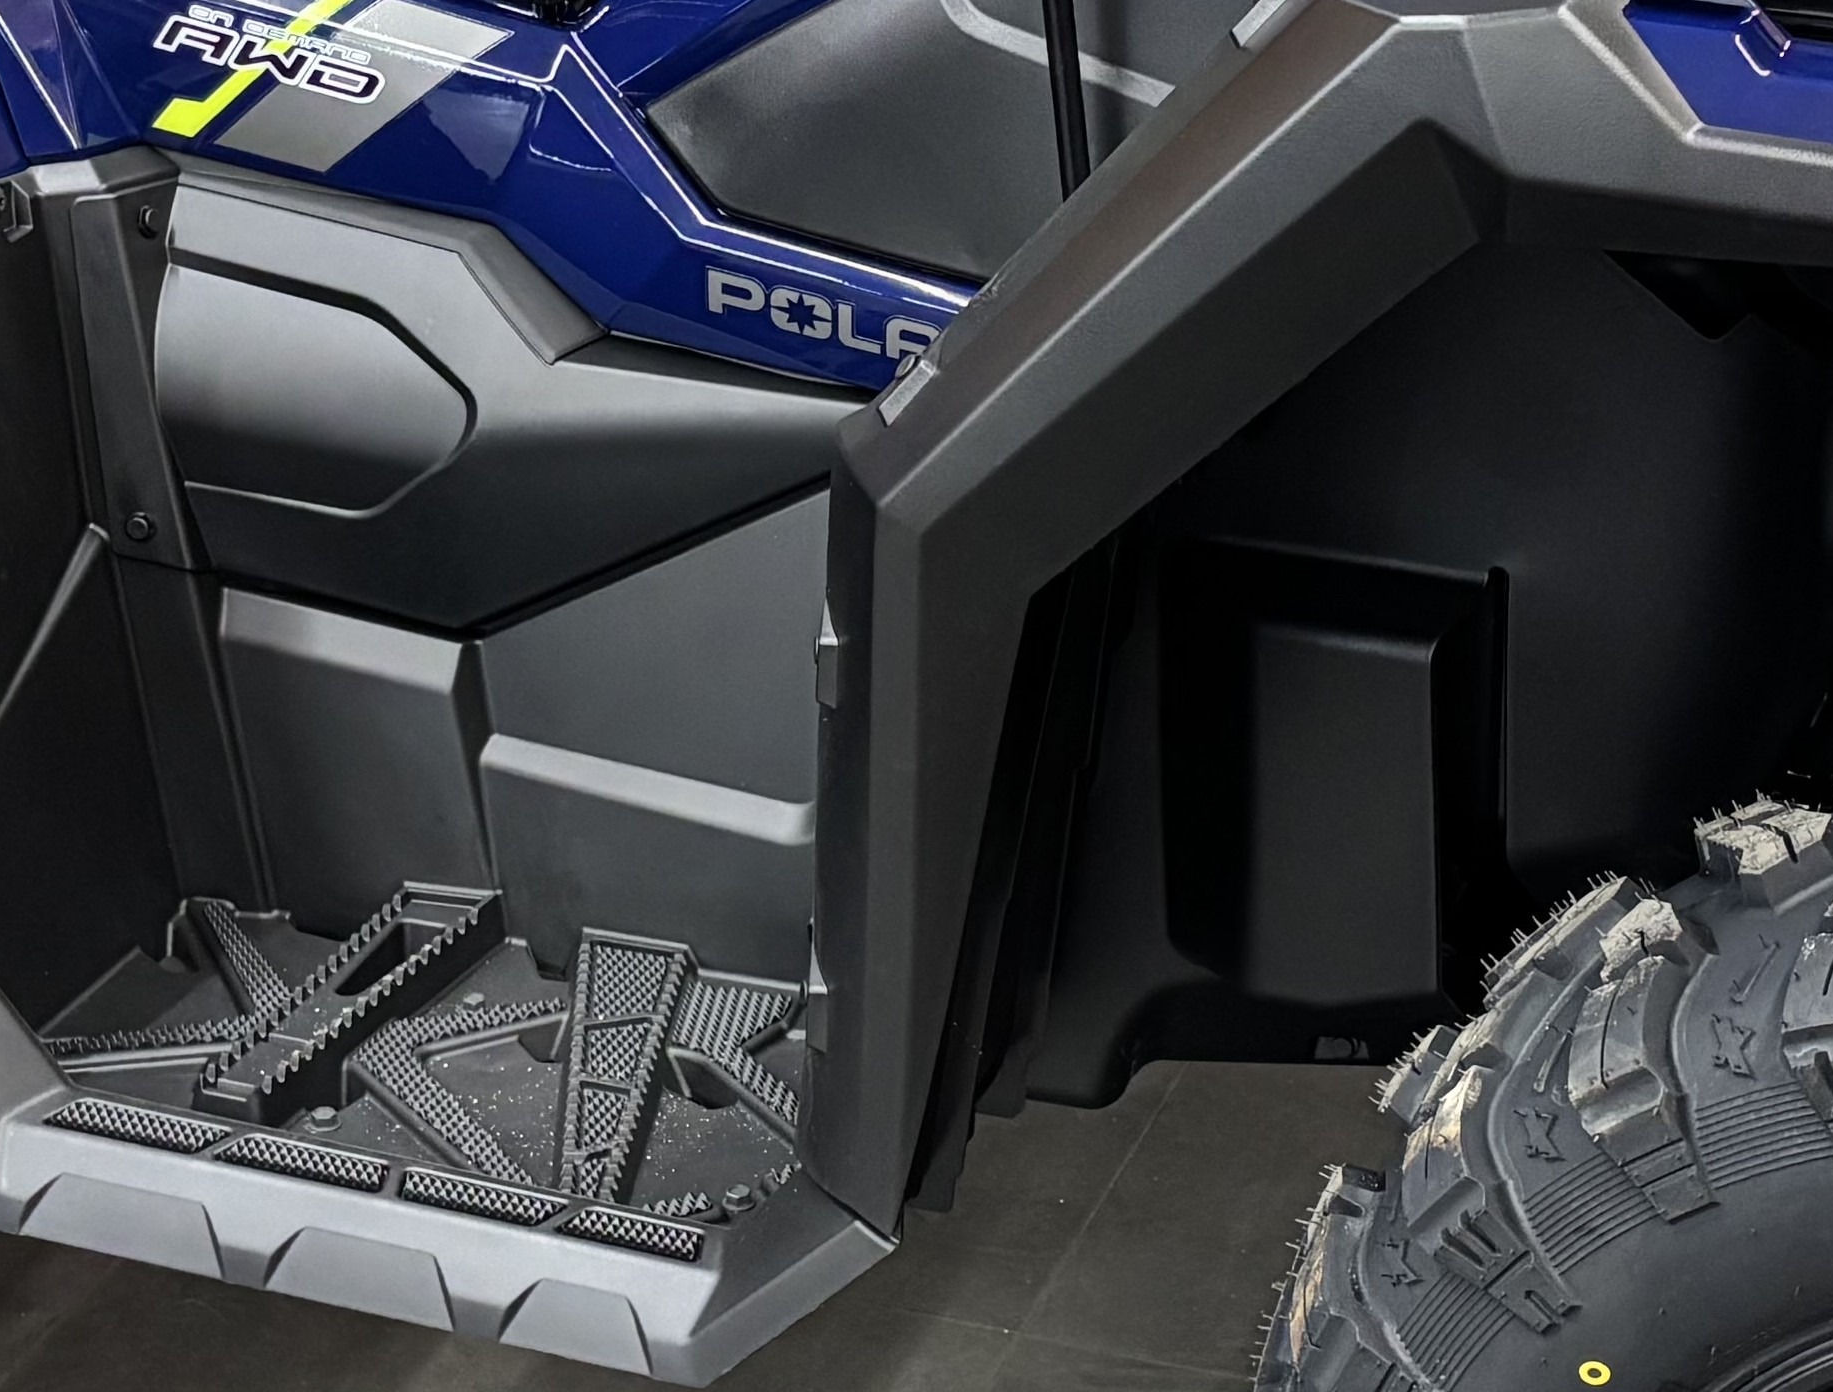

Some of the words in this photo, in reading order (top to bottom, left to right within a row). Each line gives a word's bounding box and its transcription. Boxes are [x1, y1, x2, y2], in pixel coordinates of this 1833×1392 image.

[152, 14, 386, 105] AWD
[187, 4, 235, 28] ON
[242, 18, 372, 66] DEMAND
[705, 265, 944, 361] POLA
